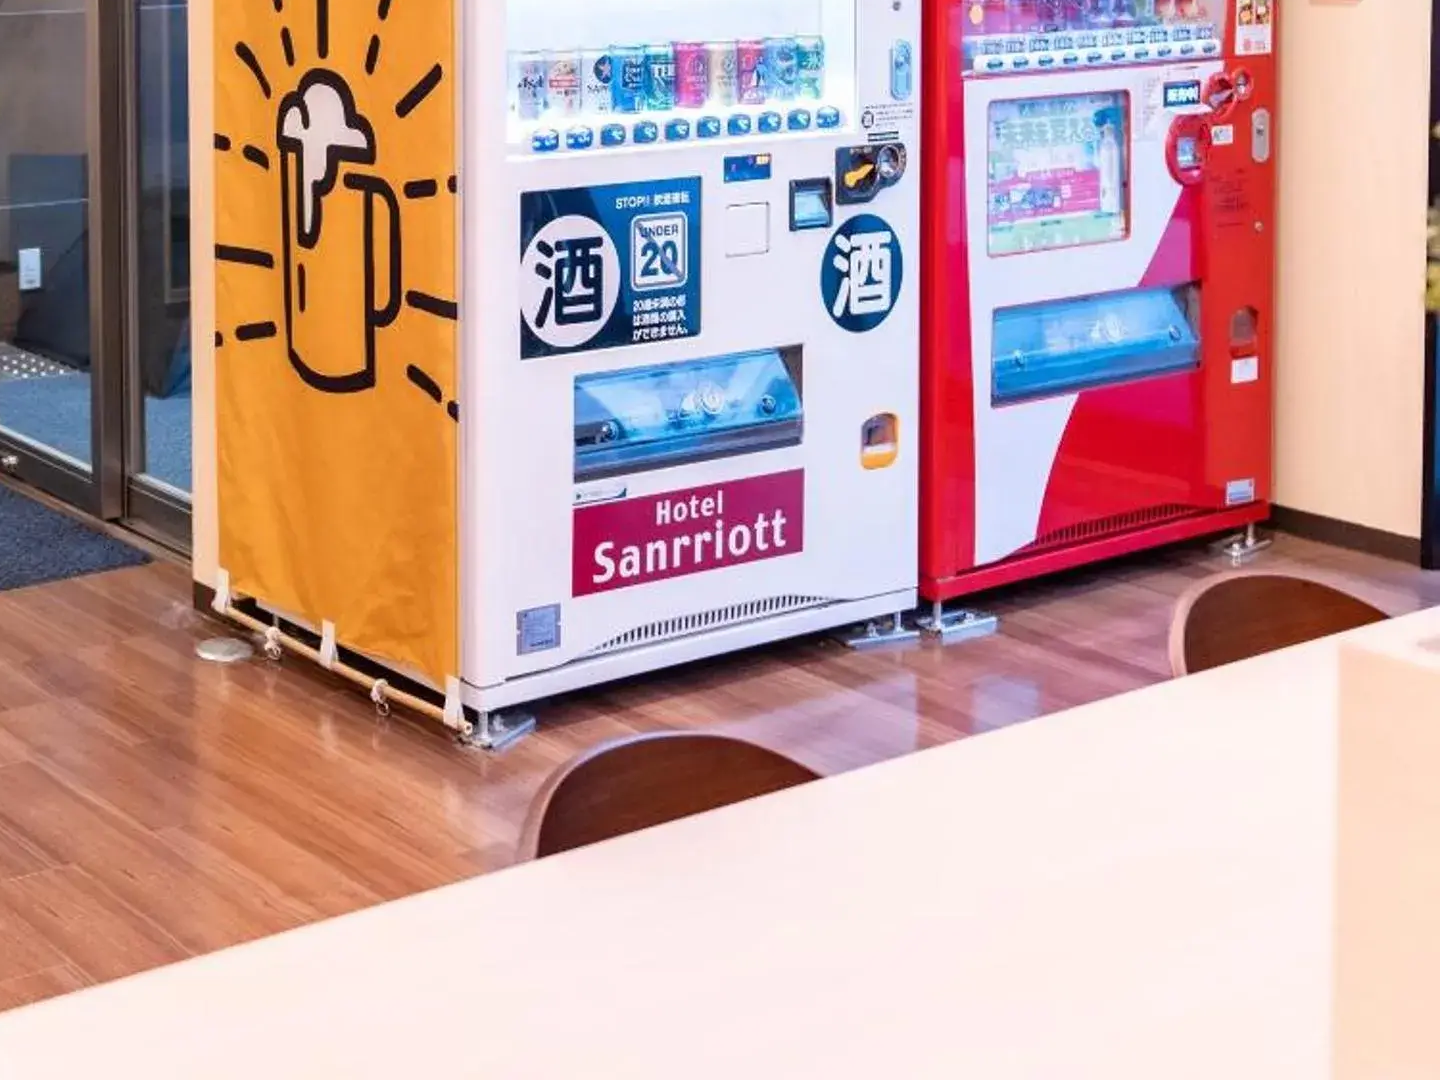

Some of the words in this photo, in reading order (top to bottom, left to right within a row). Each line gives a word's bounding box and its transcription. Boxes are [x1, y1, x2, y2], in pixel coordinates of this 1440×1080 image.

[639, 223, 679, 238] UNDER
[640, 240, 679, 278] 20
[535, 236, 603, 329] 酒
[833, 230, 892, 318] 酒
[655, 490, 724, 526] Hotel
[592, 508, 787, 585] Sanrriott
